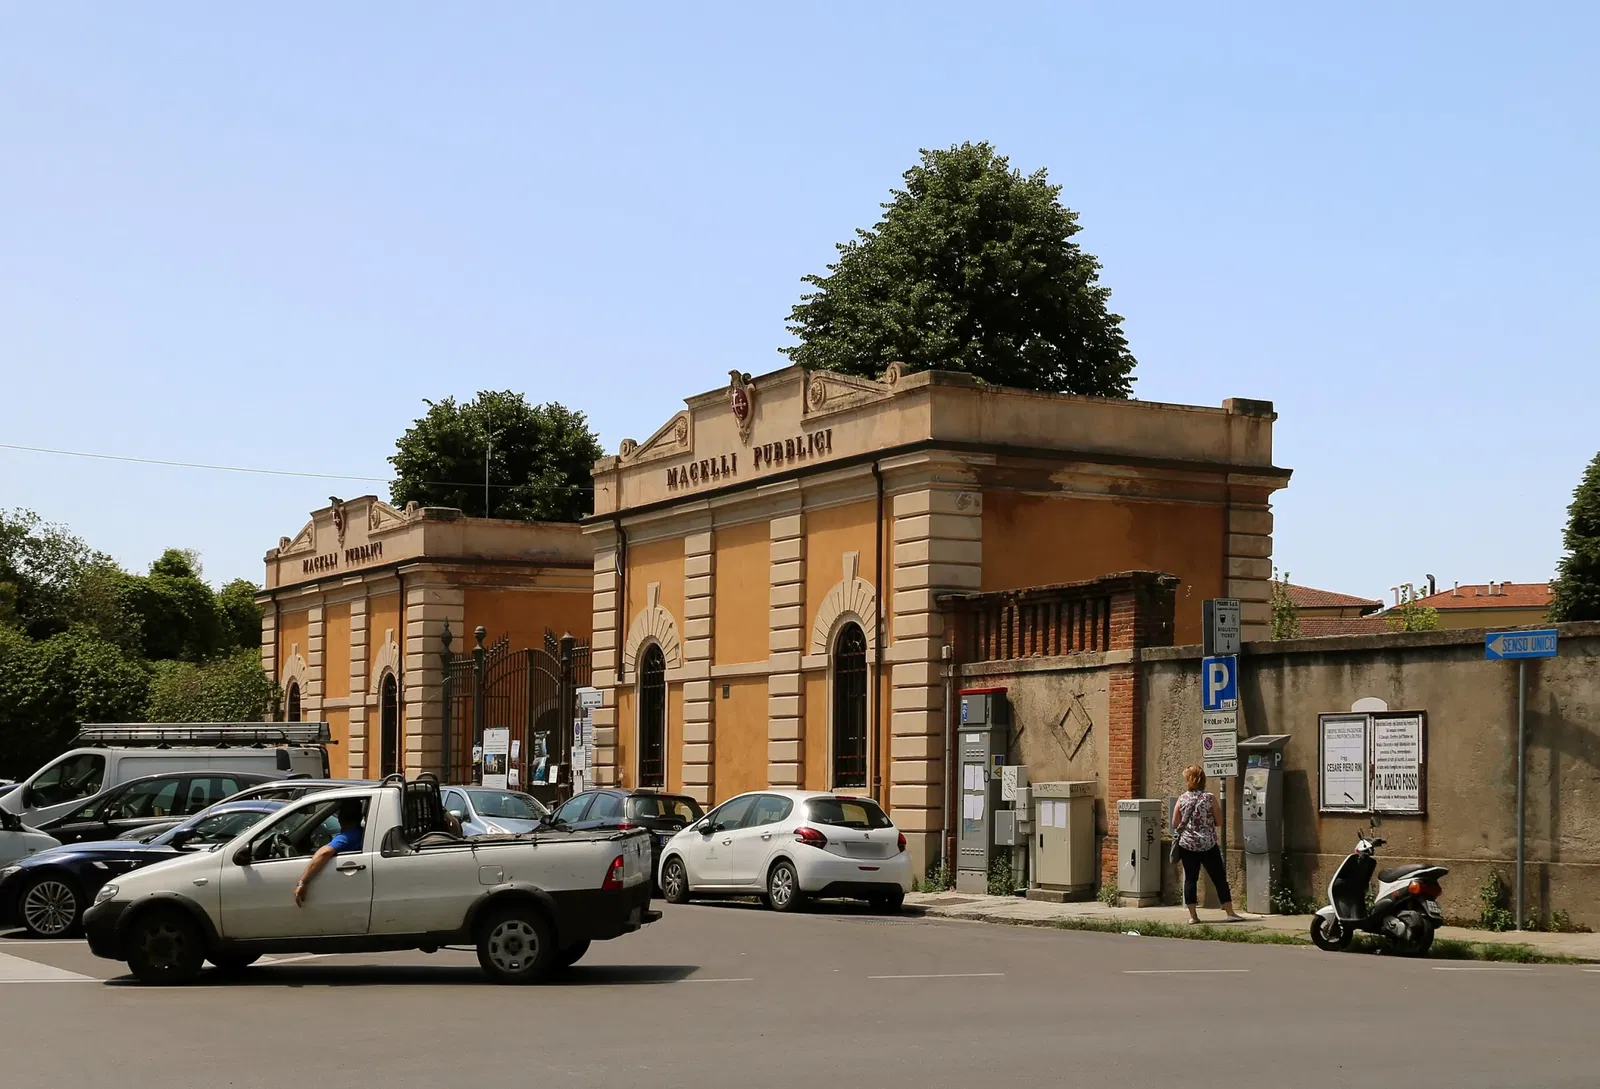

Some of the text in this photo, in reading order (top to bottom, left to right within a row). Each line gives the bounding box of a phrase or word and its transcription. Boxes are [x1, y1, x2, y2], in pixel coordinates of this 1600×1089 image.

[667, 428, 833, 487] MACELLI PUBBLICI
[303, 541, 383, 573] MACELLI PUBBLICI
[1502, 636, 1555, 652] SENSO UNICO
[1209, 663, 1229, 706] P
[1327, 763, 1342, 772] CESARE
